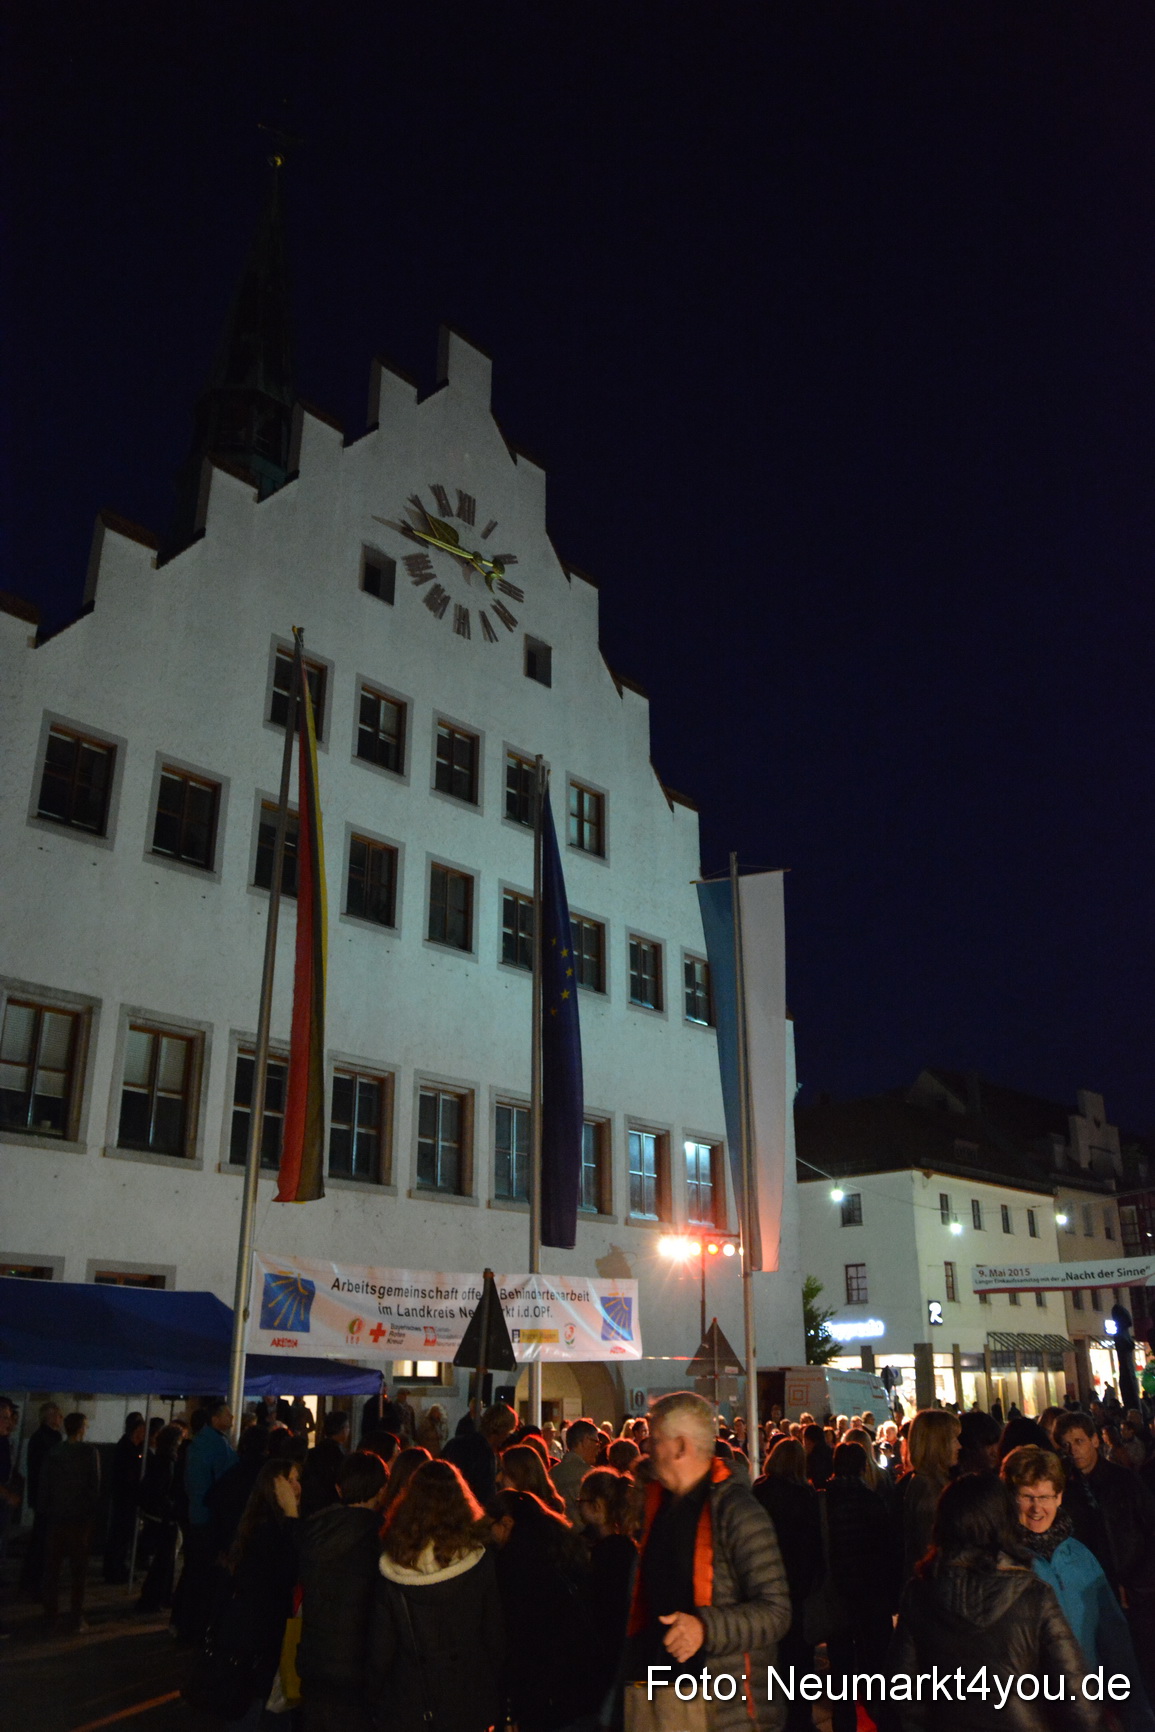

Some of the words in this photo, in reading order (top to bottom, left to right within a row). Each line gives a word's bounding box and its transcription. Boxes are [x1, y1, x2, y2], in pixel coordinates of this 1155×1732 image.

[989, 1269, 1006, 1277] Mai
[1008, 1268, 1031, 1277] 2015
[1097, 1269, 1115, 1279] der
[331, 1277, 458, 1301] Arbeitsgemeinschaft
[461, 1287, 483, 1301] offe
[378, 1302, 393, 1316] im
[397, 1304, 456, 1319] Landkreis
